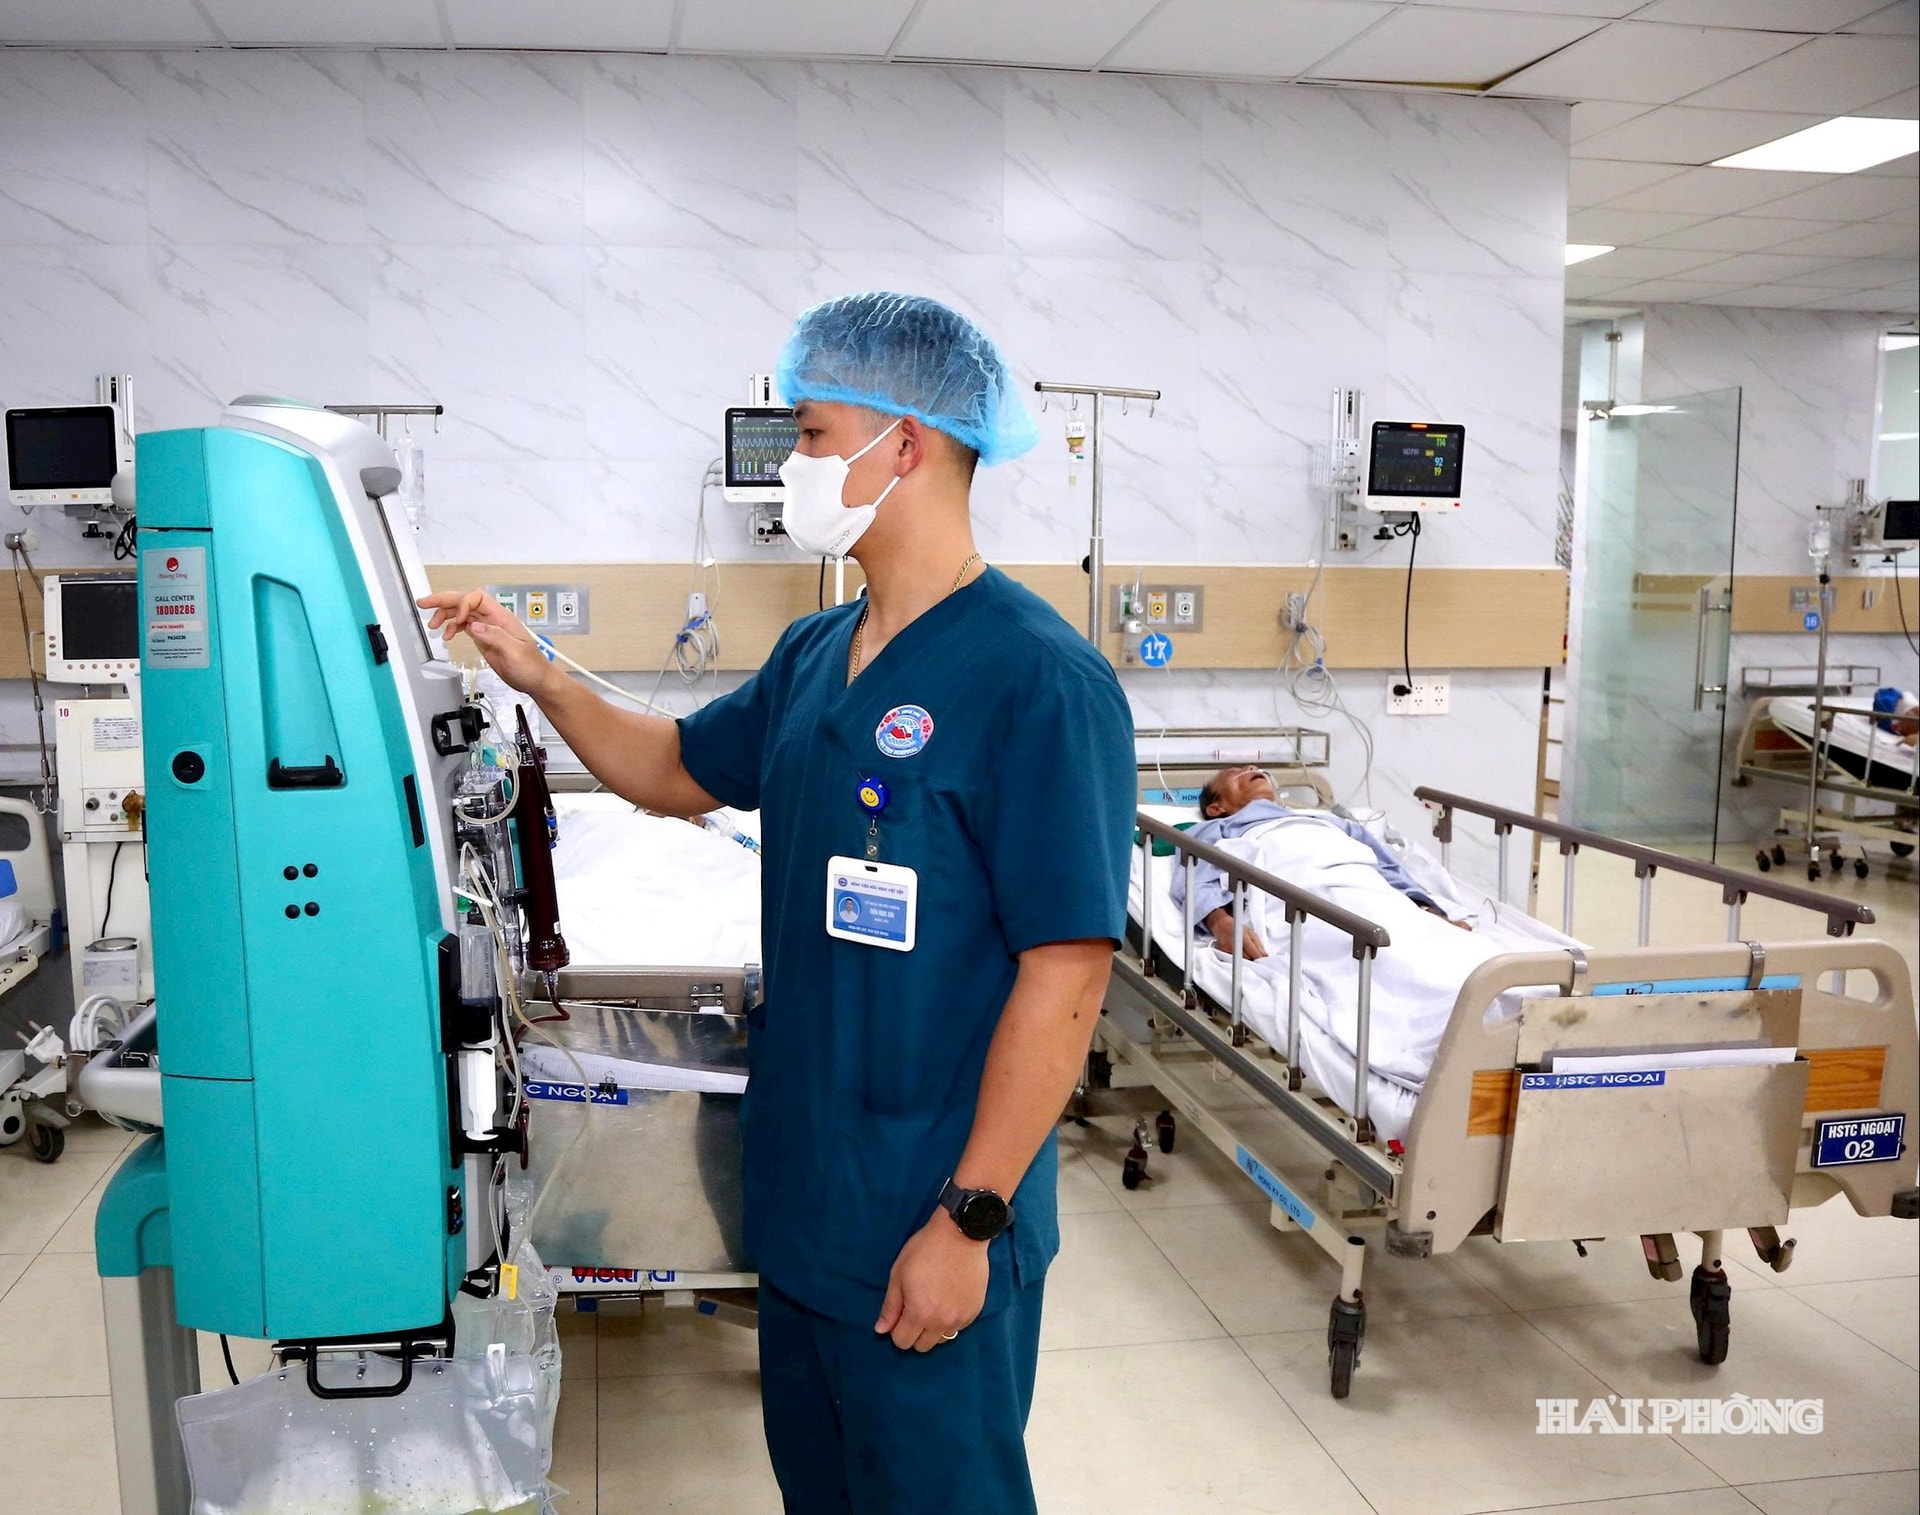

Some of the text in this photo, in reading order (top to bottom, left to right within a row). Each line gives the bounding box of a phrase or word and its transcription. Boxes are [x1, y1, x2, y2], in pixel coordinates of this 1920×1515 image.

[1434, 456, 1444, 467] 92
[156, 605, 195, 615] 18008286
[1806, 616, 1818, 628] 16
[1144, 641, 1168, 660] 17
[59, 708, 70, 718] 10
[1526, 1076, 1552, 1087] 33.
[1602, 1072, 1660, 1085] NGOẠI
[1828, 1120, 1896, 1139] HSTC NGOẠI
[1844, 1139, 1875, 1160] 02
[1290, 1203, 1301, 1217] LTD
